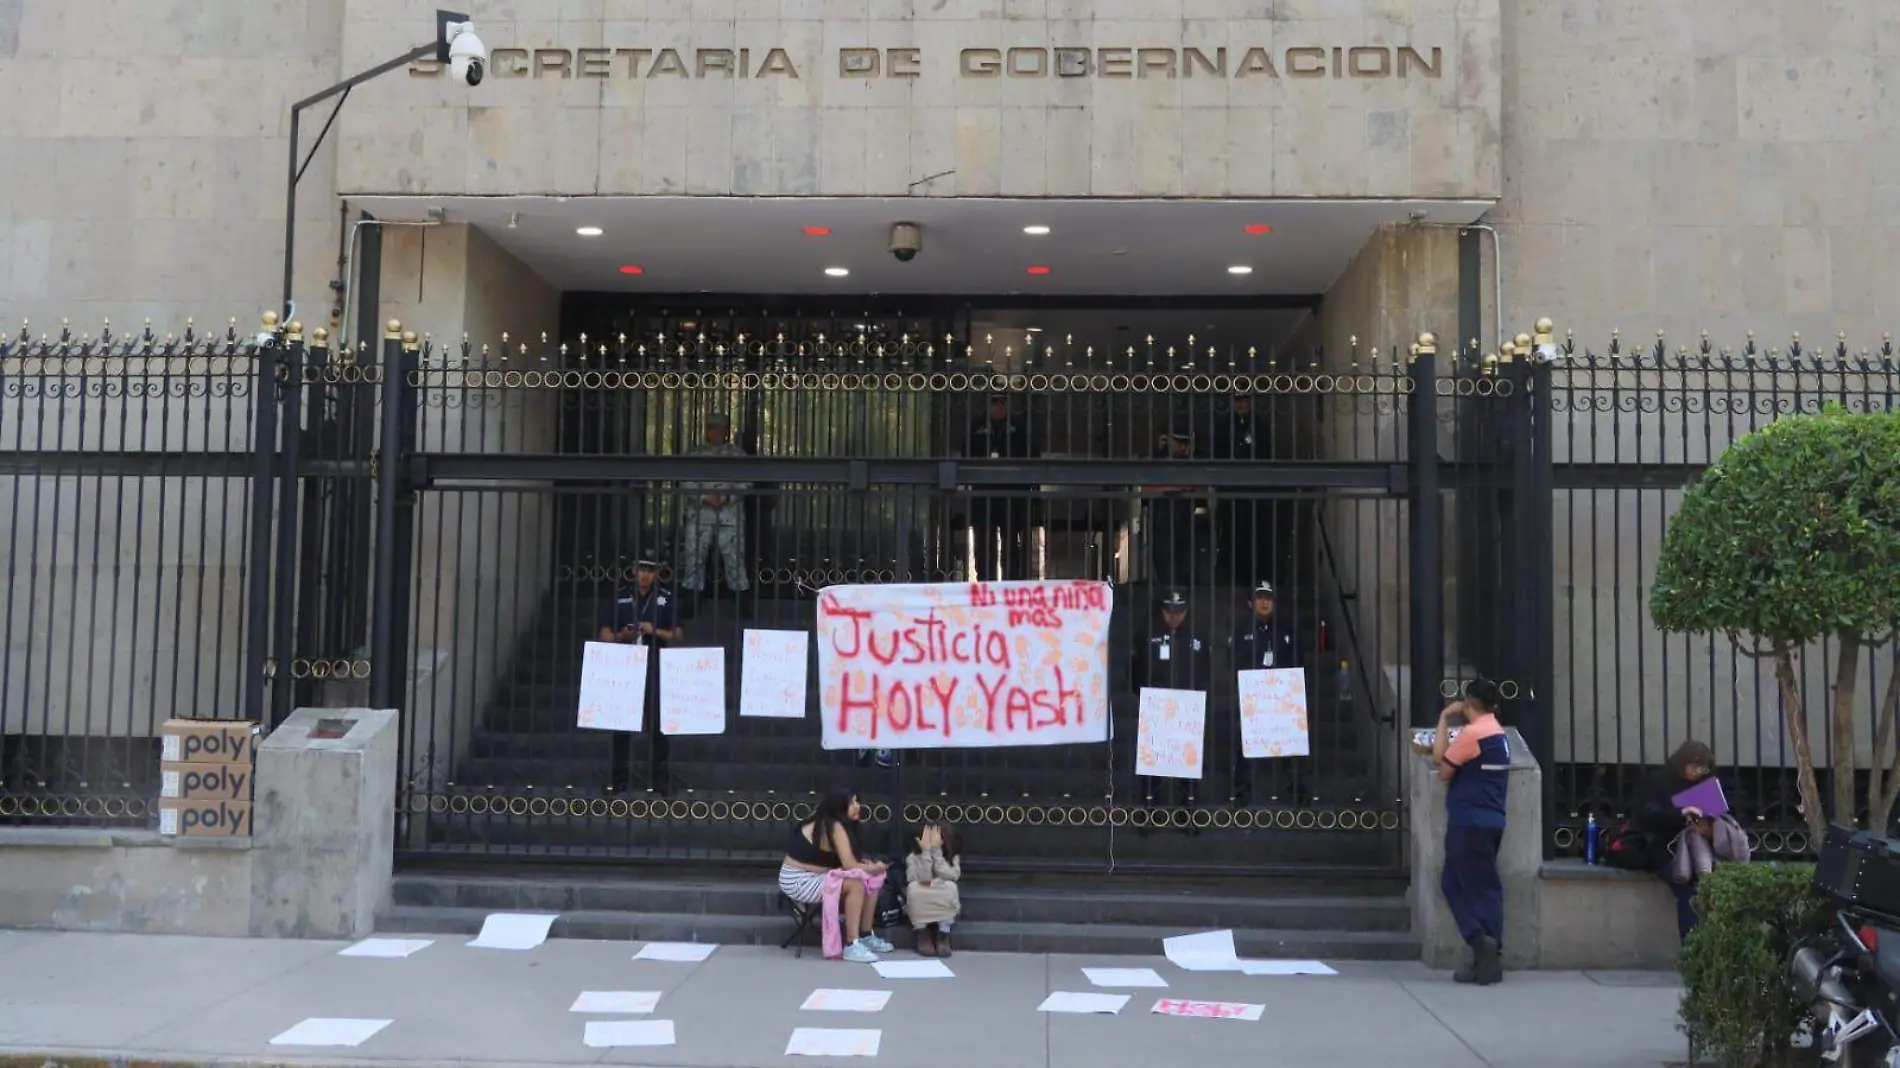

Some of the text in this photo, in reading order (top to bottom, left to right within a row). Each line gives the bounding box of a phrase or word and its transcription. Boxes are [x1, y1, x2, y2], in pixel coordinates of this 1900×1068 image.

[408, 47, 1443, 79] SCRETARIA DE GOBERNACION
[970, 578, 1106, 611] Ni una niña
[837, 672, 959, 740] HOLY
[184, 728, 246, 760] poly
[184, 766, 246, 798] poly
[182, 802, 245, 835] poly
